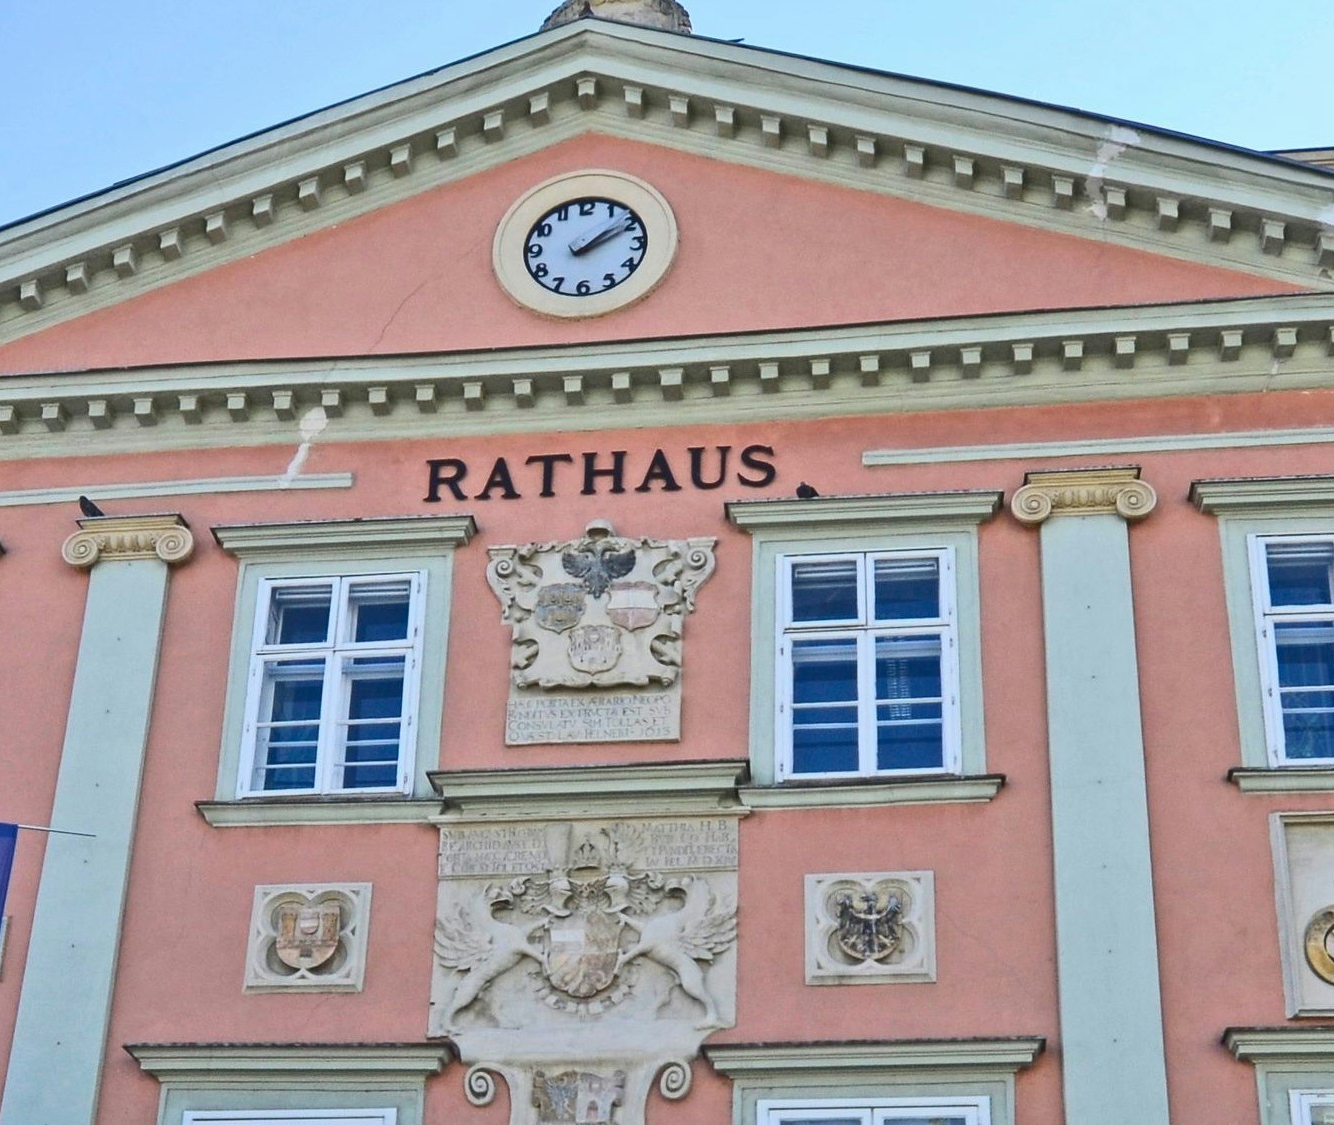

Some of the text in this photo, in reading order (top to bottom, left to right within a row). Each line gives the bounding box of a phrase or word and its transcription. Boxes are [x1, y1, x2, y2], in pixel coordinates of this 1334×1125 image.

[558, 205, 568, 221] 11
[579, 202, 595, 216] 12
[608, 204, 614, 218] 1
[537, 223, 552, 237] 10
[624, 216, 638, 231] 2
[529, 244, 543, 258] 9
[630, 236, 644, 251] 3
[535, 263, 548, 278] 8
[621, 257, 636, 273] 4
[553, 277, 565, 292] 7
[576, 280, 590, 294] 6
[603, 274, 615, 288] 5
[422, 445, 776, 502] RATHAUS
